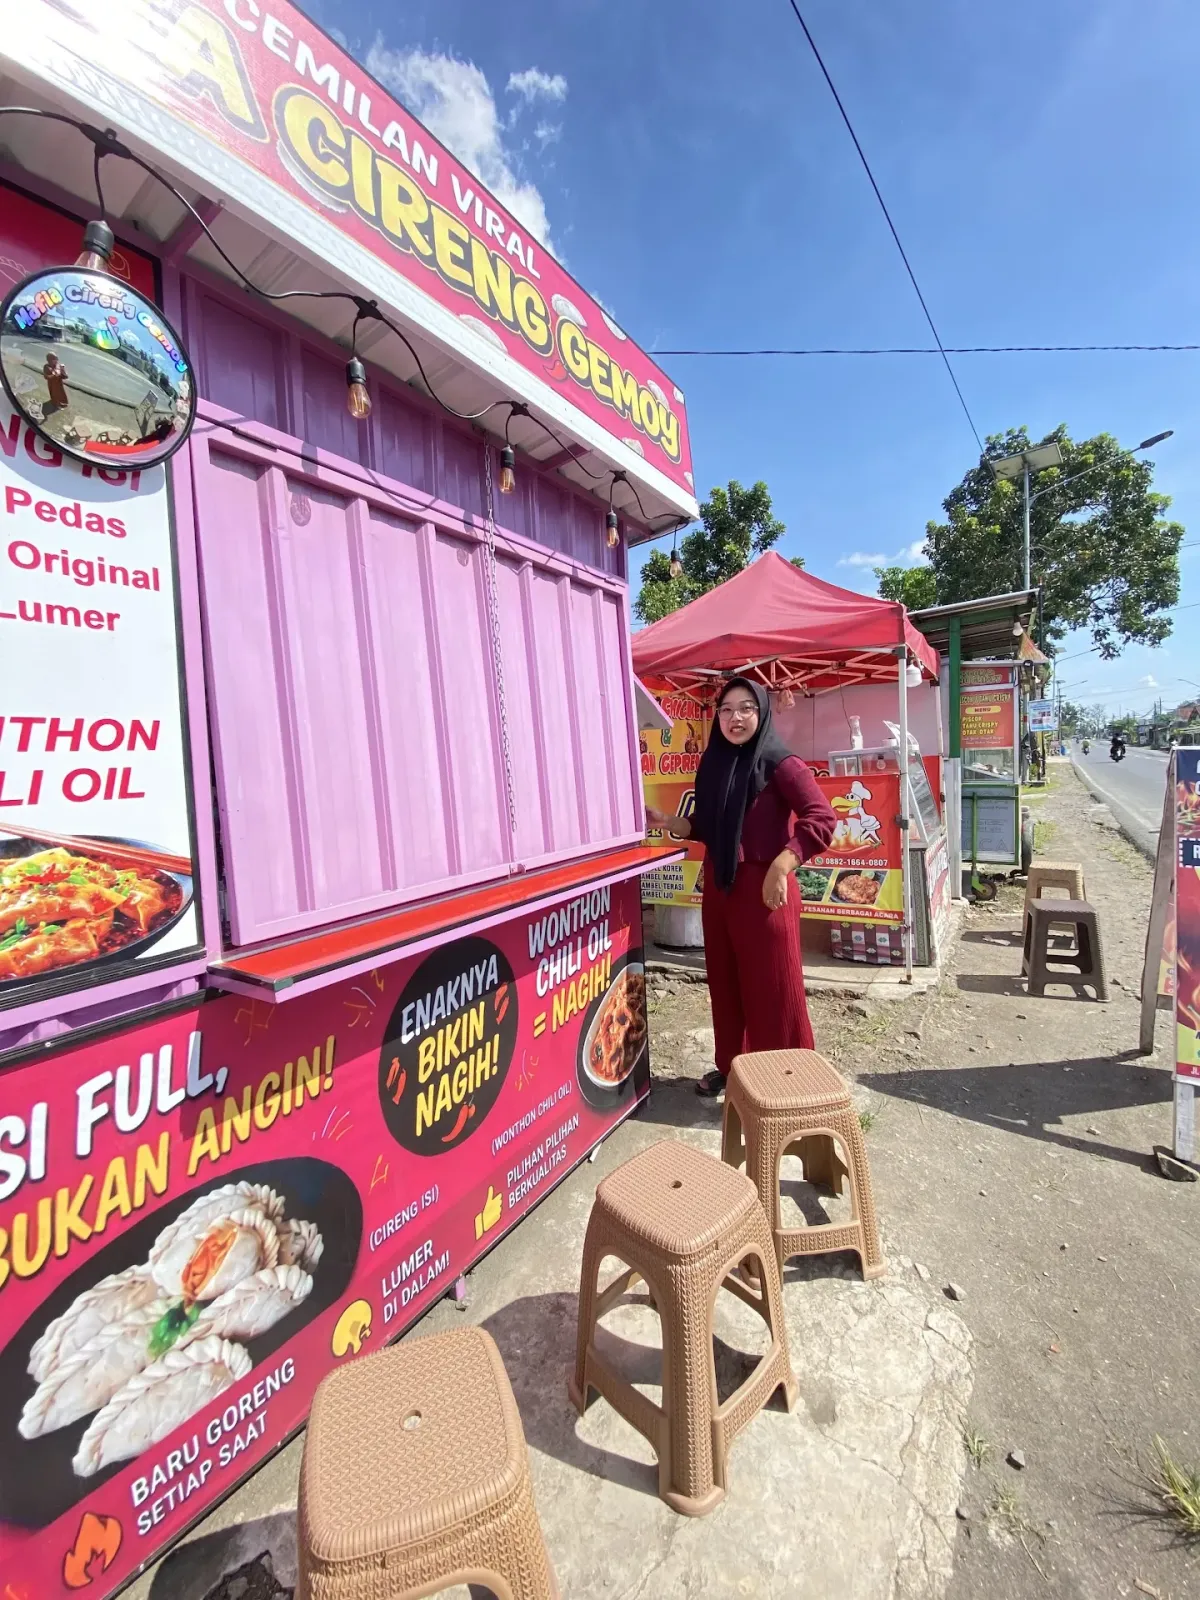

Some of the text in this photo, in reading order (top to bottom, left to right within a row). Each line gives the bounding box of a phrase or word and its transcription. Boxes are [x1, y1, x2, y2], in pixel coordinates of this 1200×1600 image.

[223, 0, 541, 280] CEMILAN VIRAL
[276, 86, 552, 354] CIRENG
[558, 318, 681, 461] GEMOY
[14, 284, 188, 373] Mafia Cireng Gemoy
[5, 485, 127, 538] Pedas
[7, 540, 160, 592] Original
[0, 717, 160, 752] THON
[62, 767, 145, 803] OIL
[663, 874, 683, 882] MATAH
[836, 908, 872, 917] BERBAGAI
[528, 884, 612, 960] WONTHON
[536, 922, 612, 997] CHILI OIL
[401, 953, 499, 1045] ENAKNYA
[552, 953, 612, 1033] NAGIH!
[418, 1001, 485, 1084] BIKIN
[76, 1030, 228, 1156] FULL,
[187, 1034, 335, 1176] ANGIN!
[416, 1034, 500, 1137] NAGIH!
[491, 1079, 573, 1156] (WONTHON CHILI OIL)
[507, 1113, 580, 1188] PILIHAN PILIHAN
[508, 1145, 567, 1209] BERKUALITAS
[369, 1184, 440, 1252] (CIRENG ISI)
[381, 1239, 434, 1298] LUMER
[383, 1250, 450, 1324] DI DALAM!
[130, 1357, 296, 1506] BARU GORENG
[137, 1411, 268, 1536] SETIAP SAAT
